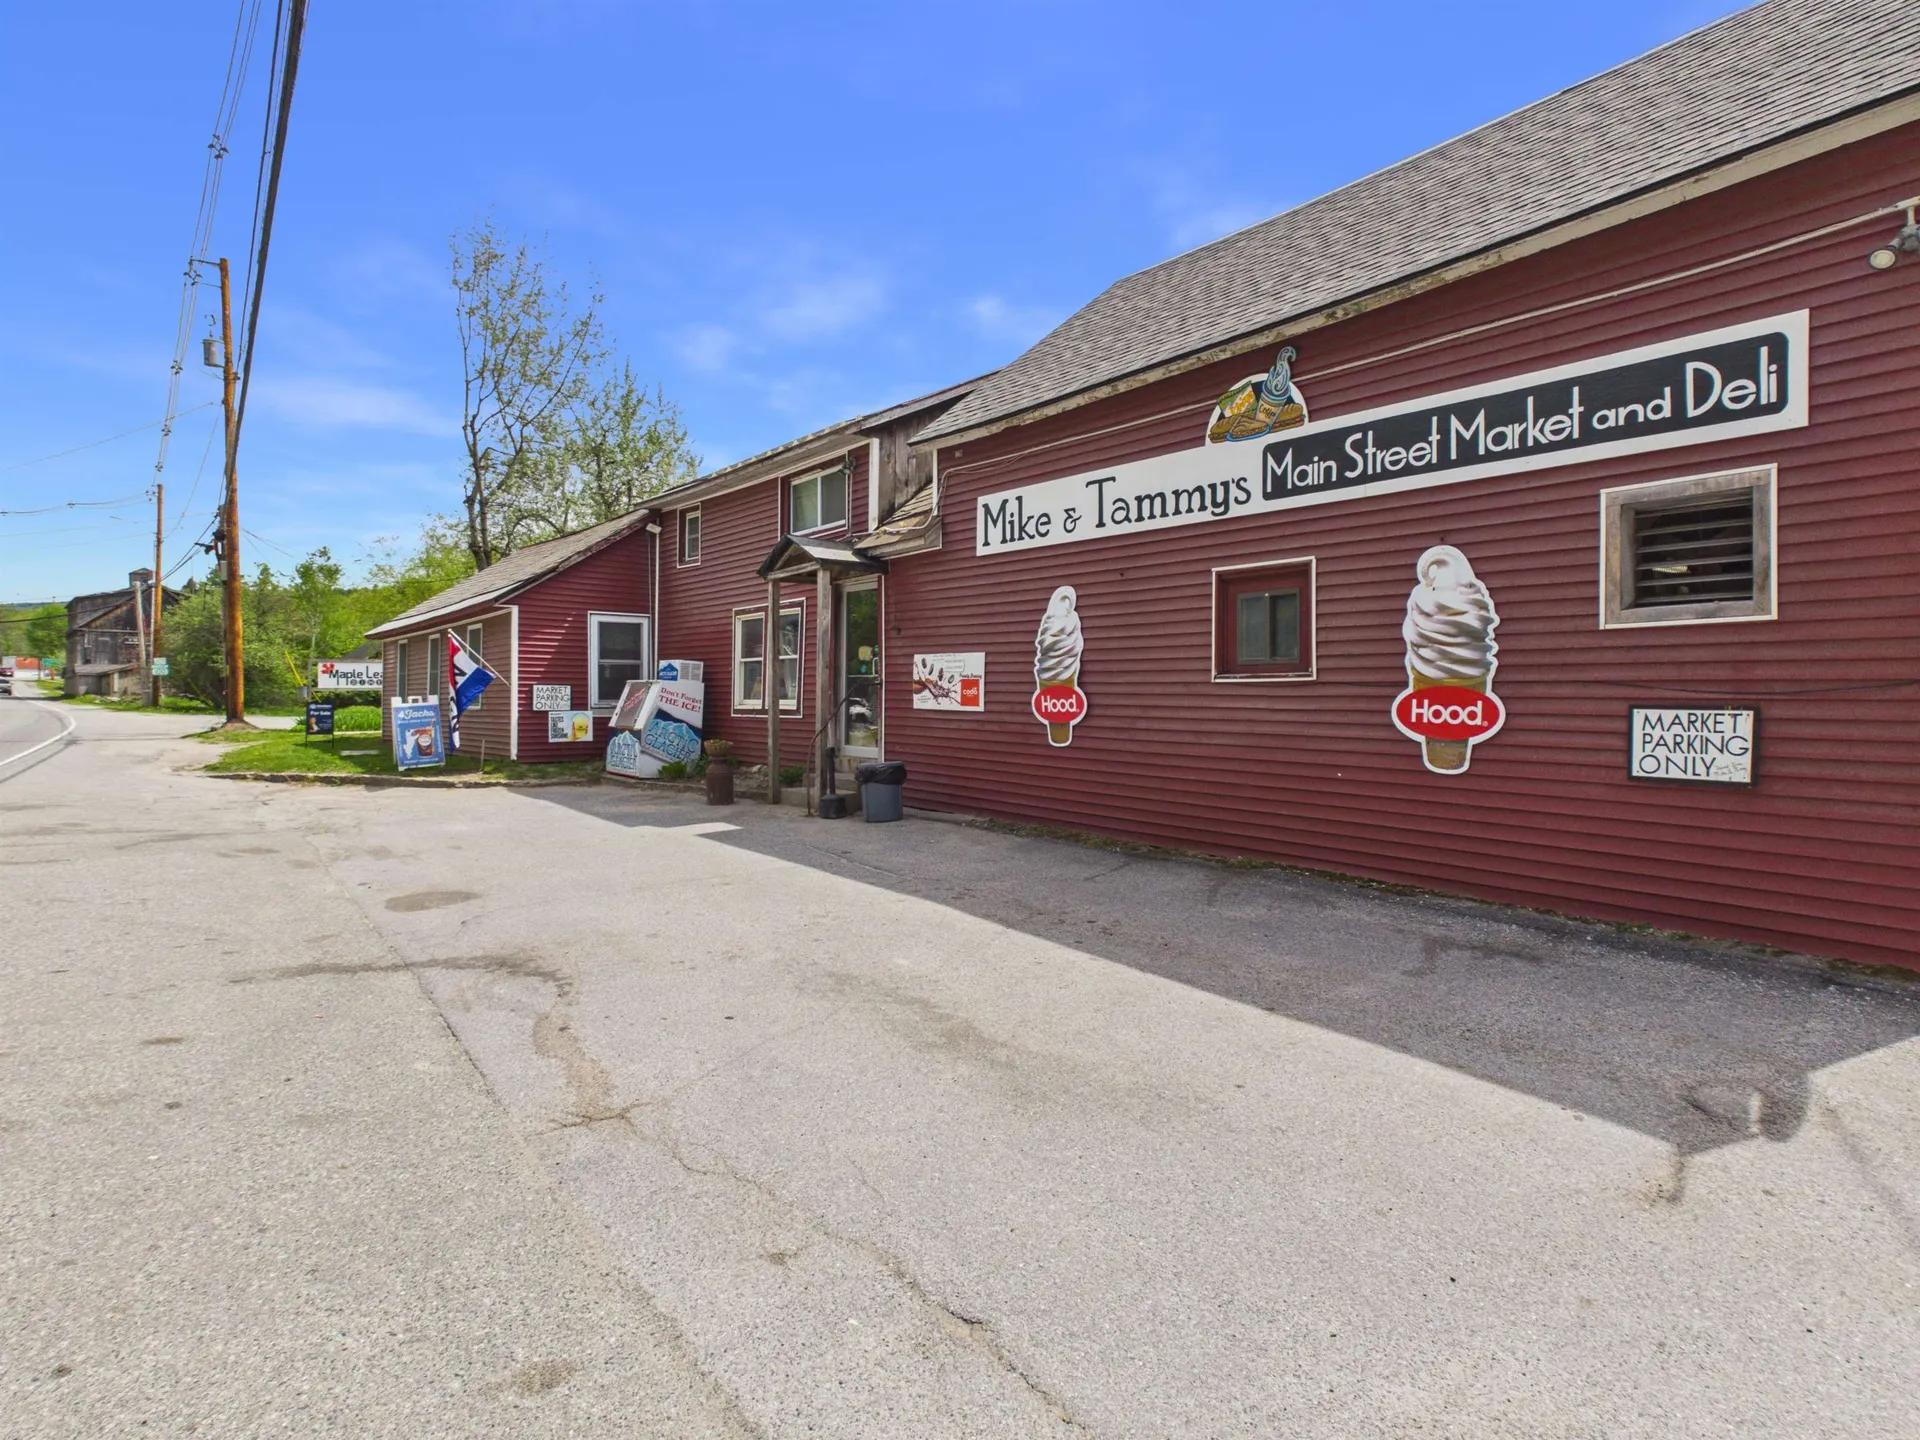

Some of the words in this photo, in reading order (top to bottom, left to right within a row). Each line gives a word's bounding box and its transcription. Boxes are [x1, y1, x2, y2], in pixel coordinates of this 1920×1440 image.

[1265, 447, 1337, 493] Main
[1344, 416, 1441, 479] Street
[1450, 386, 1584, 460] Market
[1592, 386, 1672, 430] and
[1685, 346, 1778, 418] Deli
[982, 496, 1051, 547] Mike
[1063, 507, 1082, 533] &
[1085, 476, 1252, 528] Tammy's
[329, 669, 363, 685] Maple
[536, 686, 568, 694] MARKET
[536, 694, 570, 702] PARKING
[660, 687, 679, 698] Don't
[535, 701, 561, 710] ONLY
[659, 695, 679, 707] THE
[681, 701, 701, 713] ICE!
[1642, 713, 1743, 734] MARKET
[648, 722, 699, 753] ARCTIC
[1642, 733, 1750, 757] PARKING
[645, 734, 692, 763] GLACIER
[1639, 754, 1717, 777] ONLY
